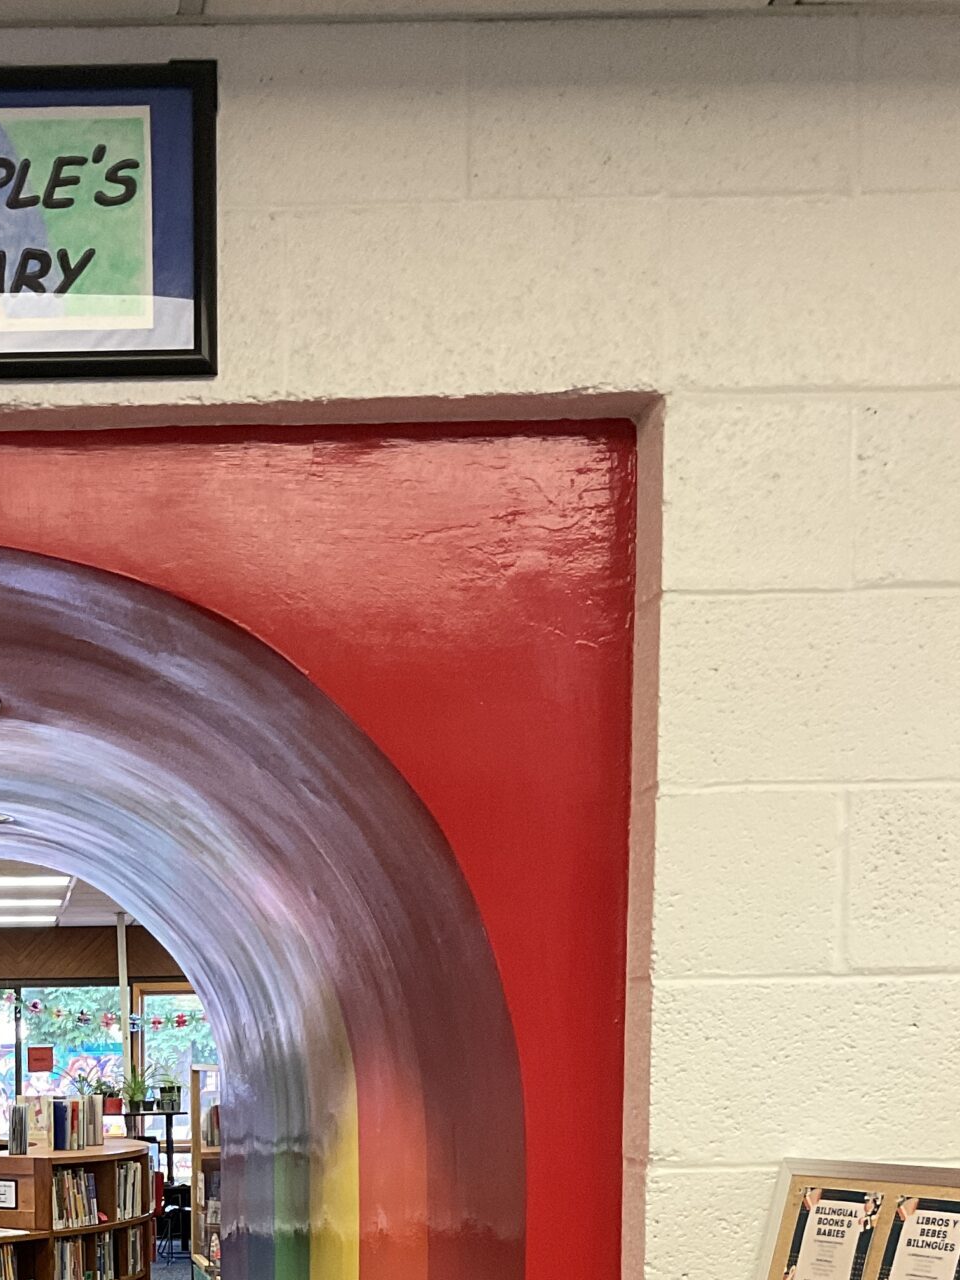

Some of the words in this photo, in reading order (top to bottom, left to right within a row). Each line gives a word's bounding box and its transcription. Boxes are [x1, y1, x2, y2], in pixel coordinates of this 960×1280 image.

[815, 1206, 859, 1218] BILINGUAL
[817, 1217, 845, 1228] BOOKS
[916, 1216, 950, 1227] LIBROS
[952, 1219, 959, 1228] Y
[816, 1229, 846, 1239] BABIES
[919, 1227, 948, 1239] BEBÉS
[906, 1238, 956, 1252] BILINGÜES
